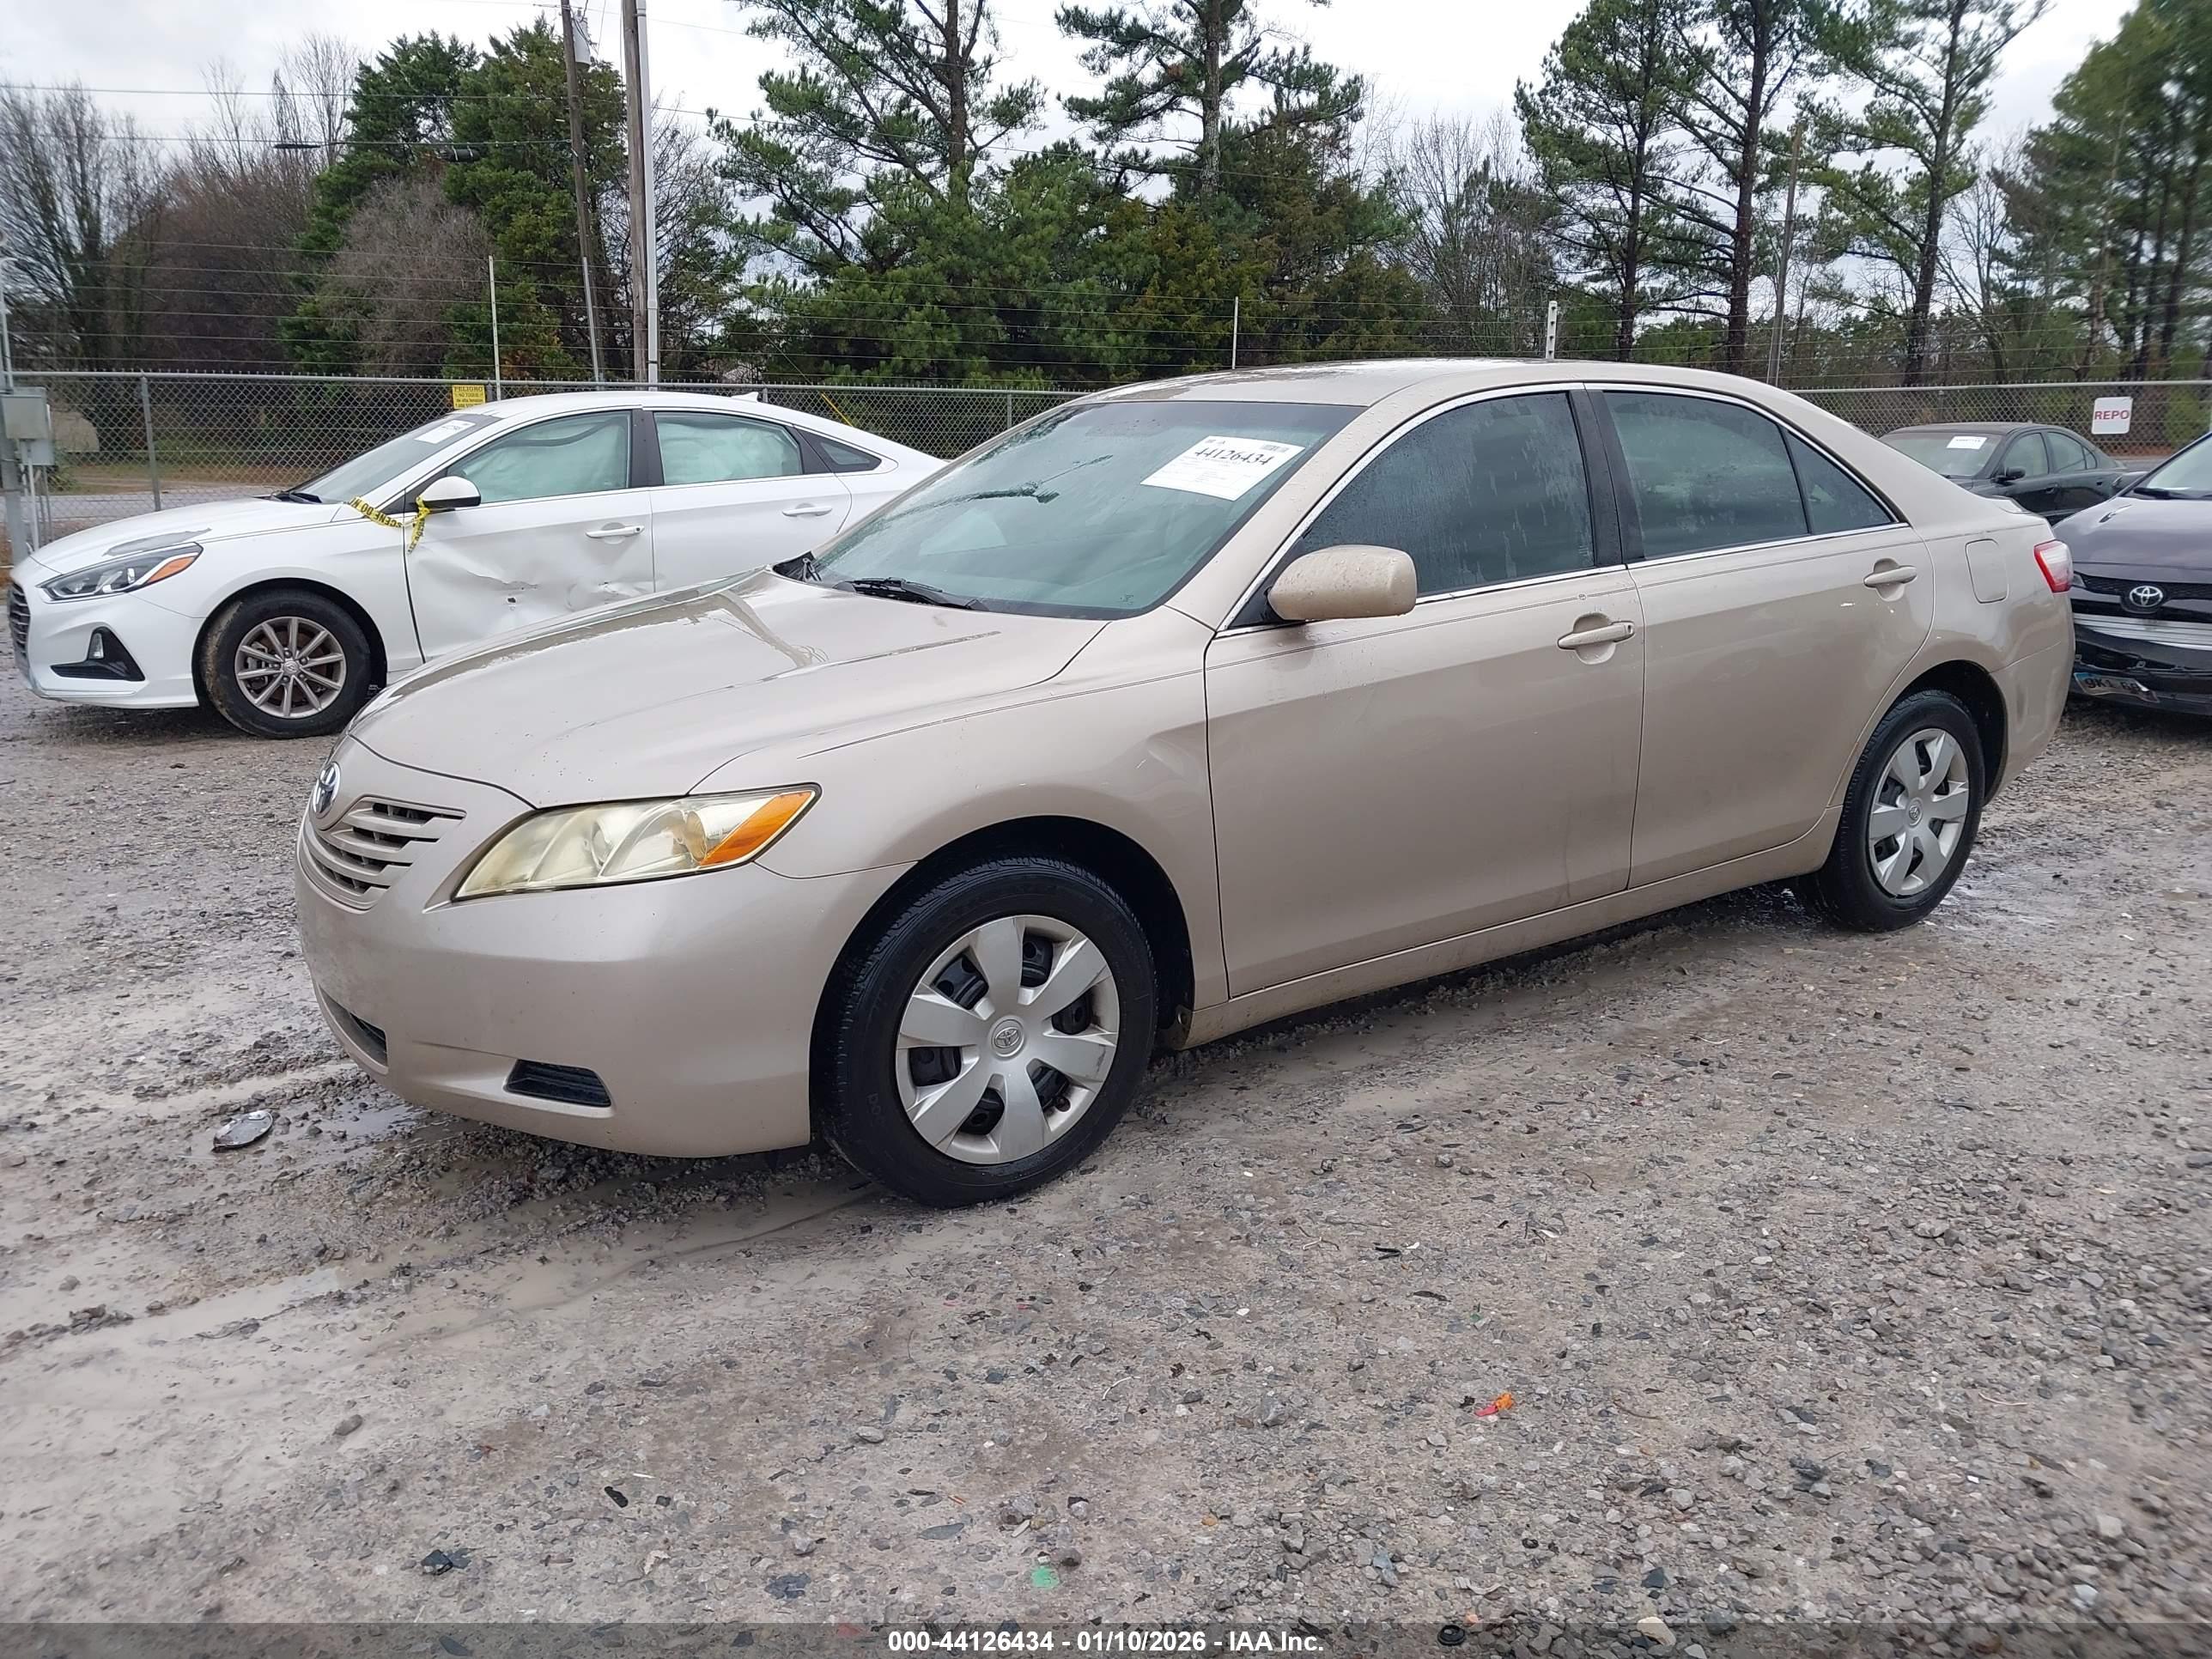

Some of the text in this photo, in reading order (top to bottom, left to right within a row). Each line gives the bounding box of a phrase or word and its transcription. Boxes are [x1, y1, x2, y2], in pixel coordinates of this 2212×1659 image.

[2094, 410, 2130, 420] REPO
[1194, 447, 1275, 465] 44126434
[361, 502, 374, 516] DO
[373, 511, 403, 528] SCENE
